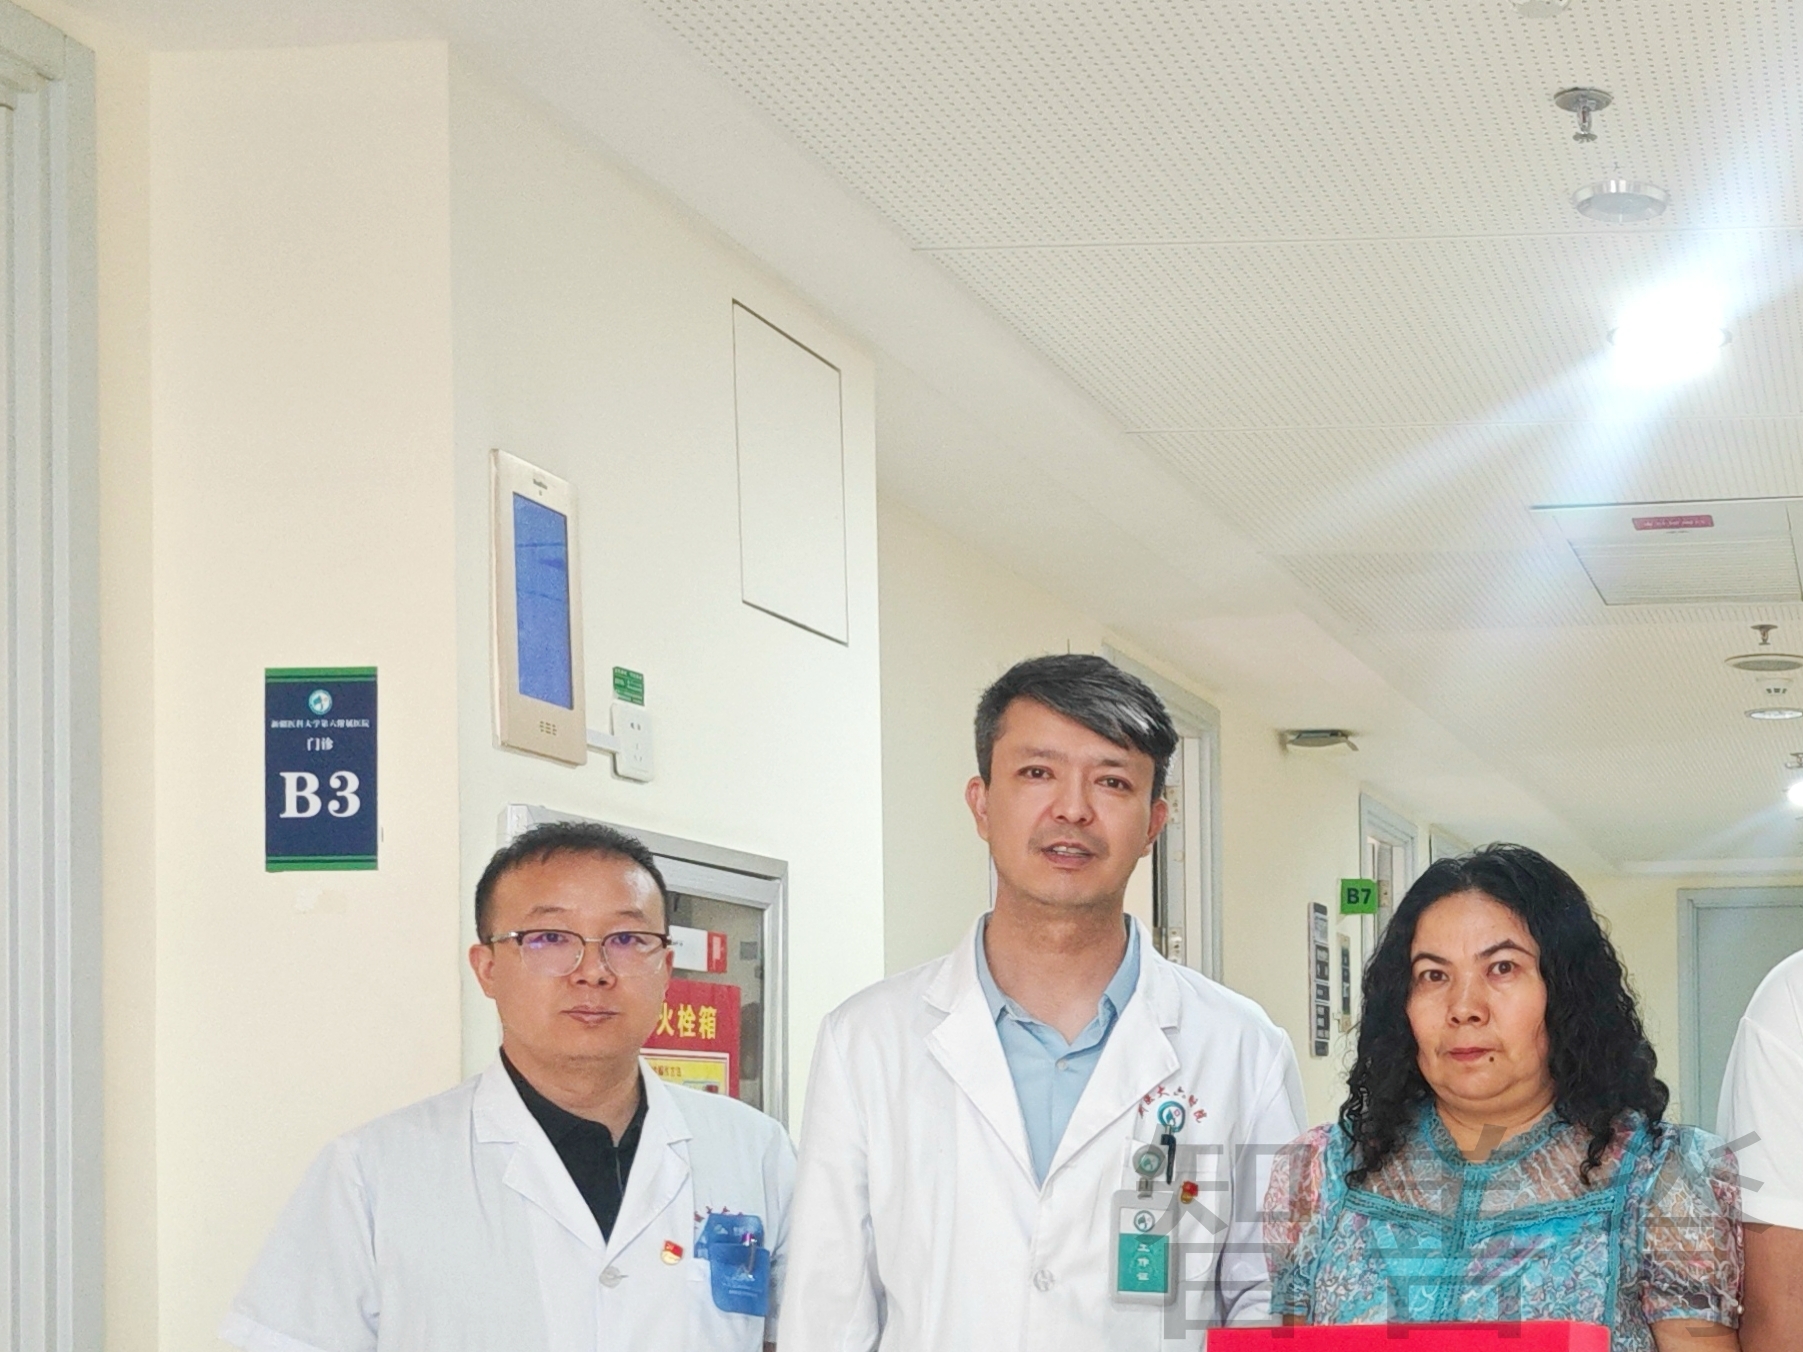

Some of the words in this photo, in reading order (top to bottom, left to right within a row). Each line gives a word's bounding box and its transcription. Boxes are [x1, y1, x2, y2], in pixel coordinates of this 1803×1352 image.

[307, 737, 334, 751] 门诊
[279, 771, 361, 818] B3
[1347, 888, 1372, 904] B7
